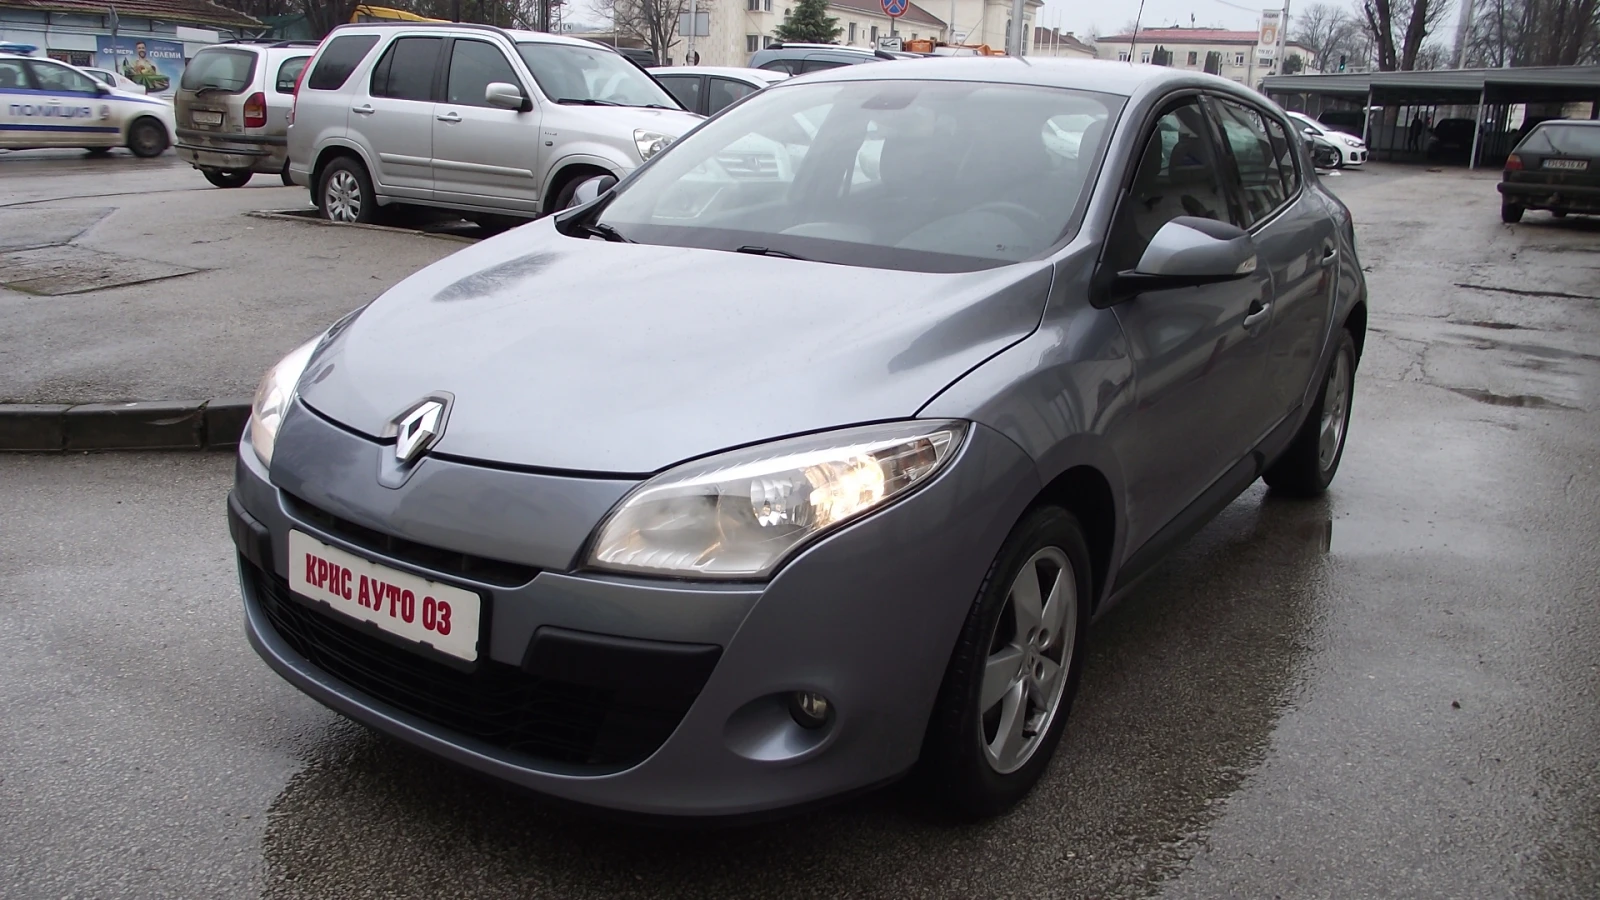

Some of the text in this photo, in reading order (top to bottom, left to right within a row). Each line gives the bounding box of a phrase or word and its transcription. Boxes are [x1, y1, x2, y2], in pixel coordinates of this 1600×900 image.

[149, 50, 181, 59] ГОЛЕМИ
[9, 104, 92, 118] ПОЛИЦИЯ
[305, 553, 352, 600] КРИС
[358, 574, 415, 624] АУТО
